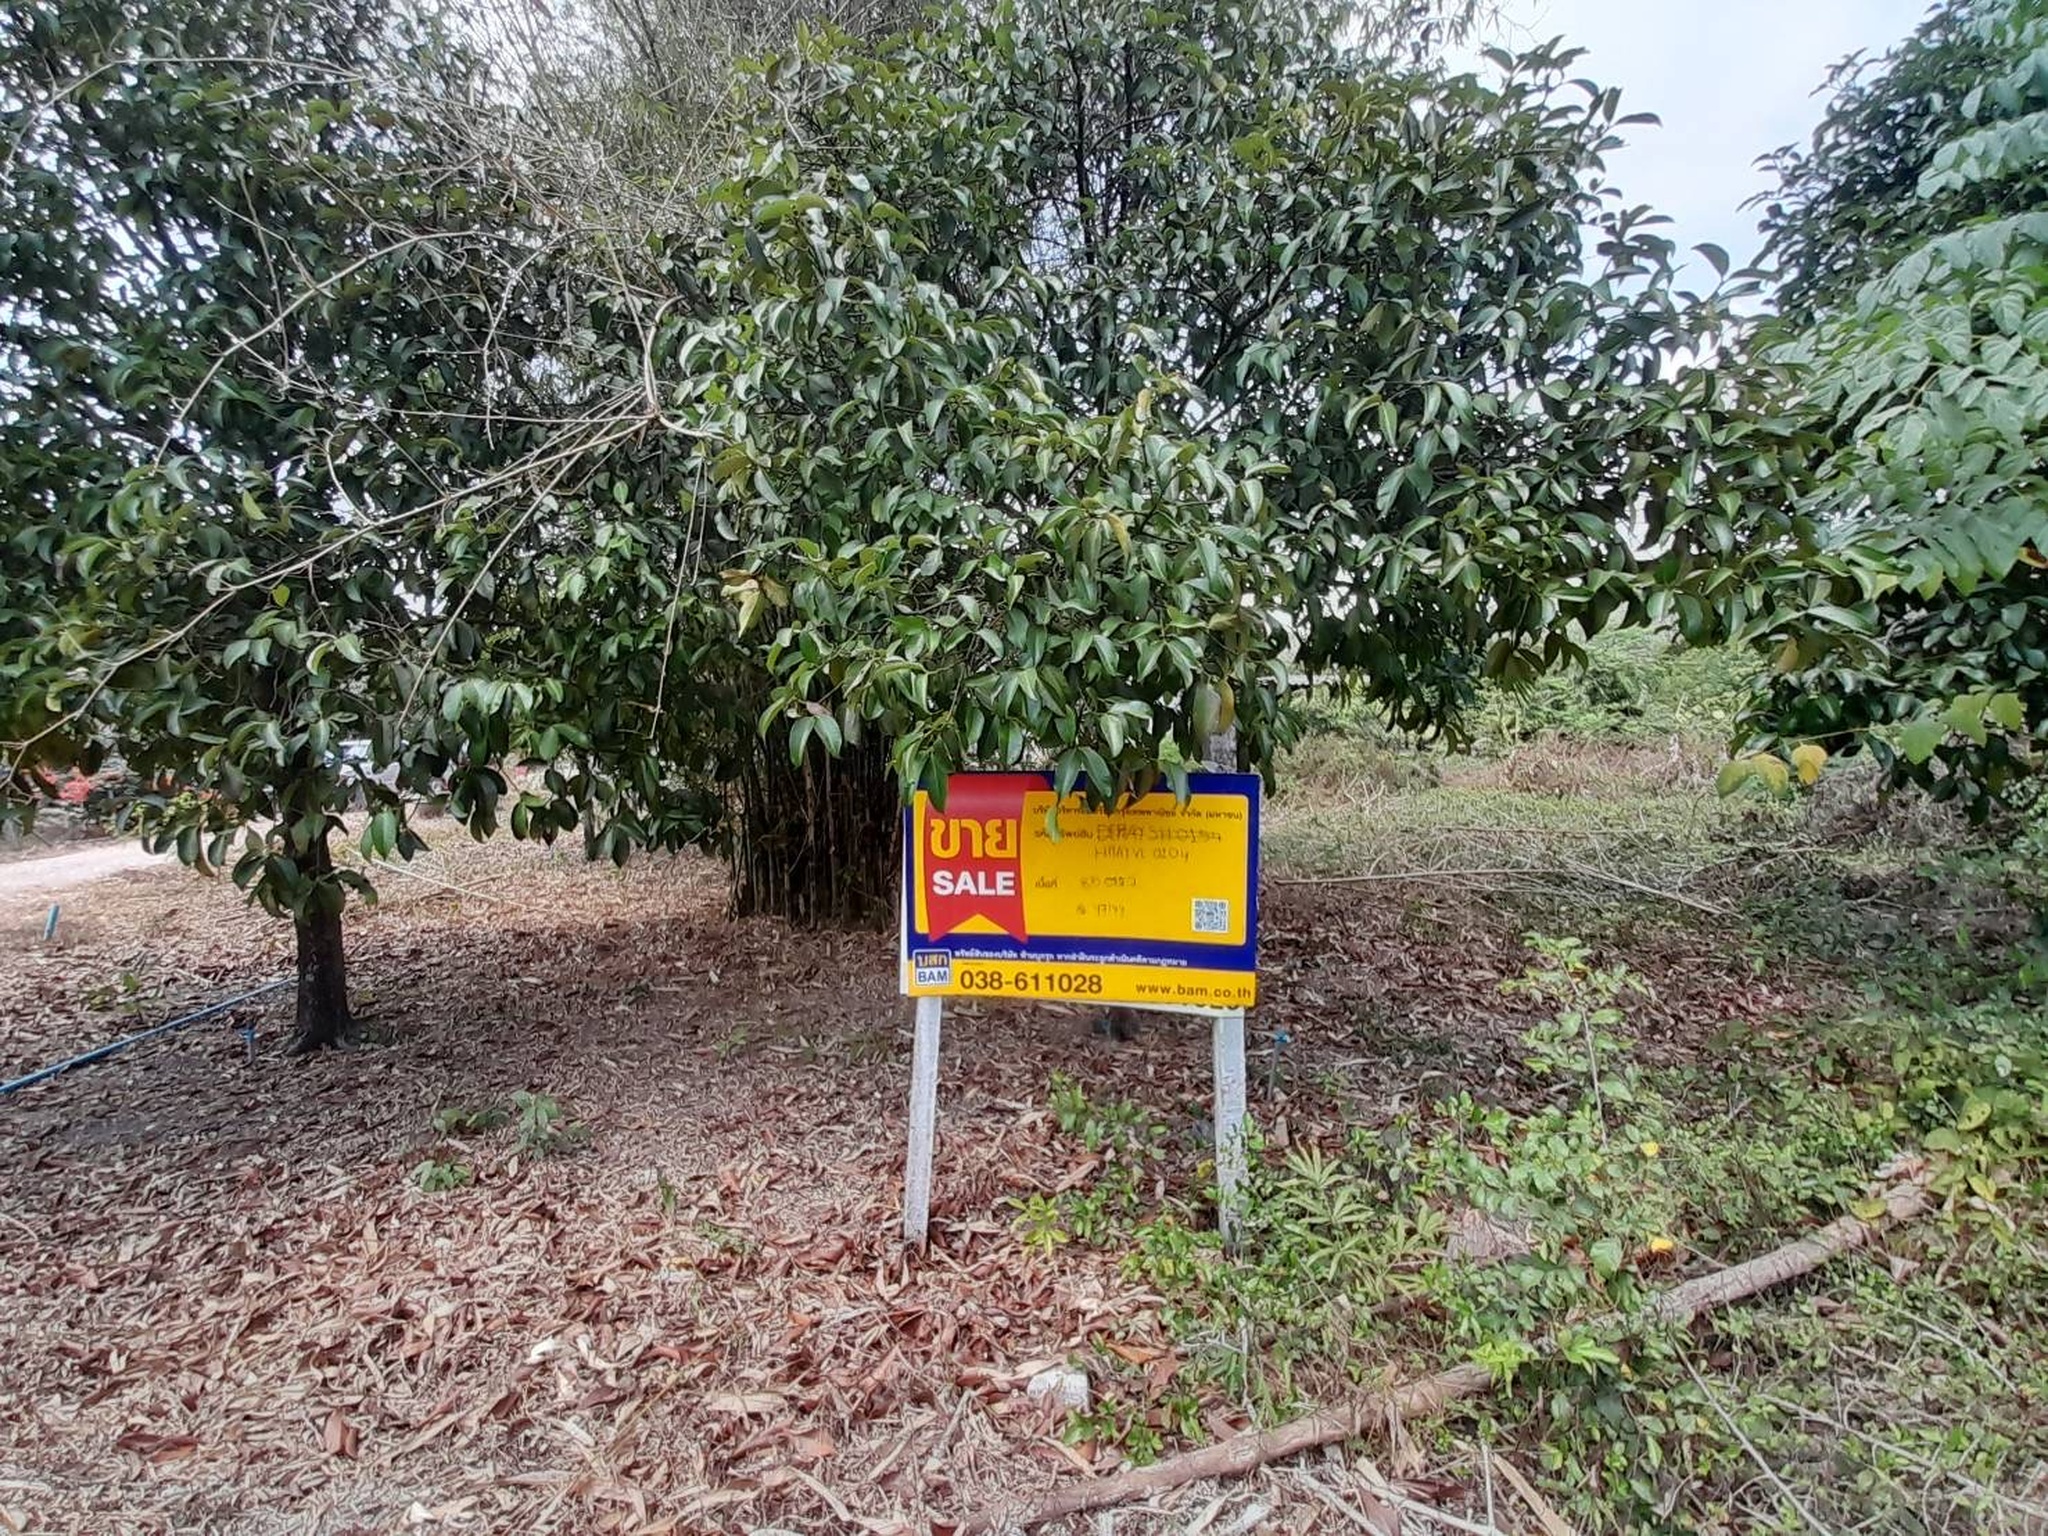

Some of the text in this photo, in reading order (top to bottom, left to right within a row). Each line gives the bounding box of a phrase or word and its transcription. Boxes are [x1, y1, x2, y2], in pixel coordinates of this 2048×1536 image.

[1205, 809, 1243, 821] (มหาชน)
[930, 819, 1017, 858] ขาย
[932, 870, 1015, 896] SALE
[917, 970, 948, 983] BAM
[960, 970, 1252, 999] 038-611028 www.bam.co.th
